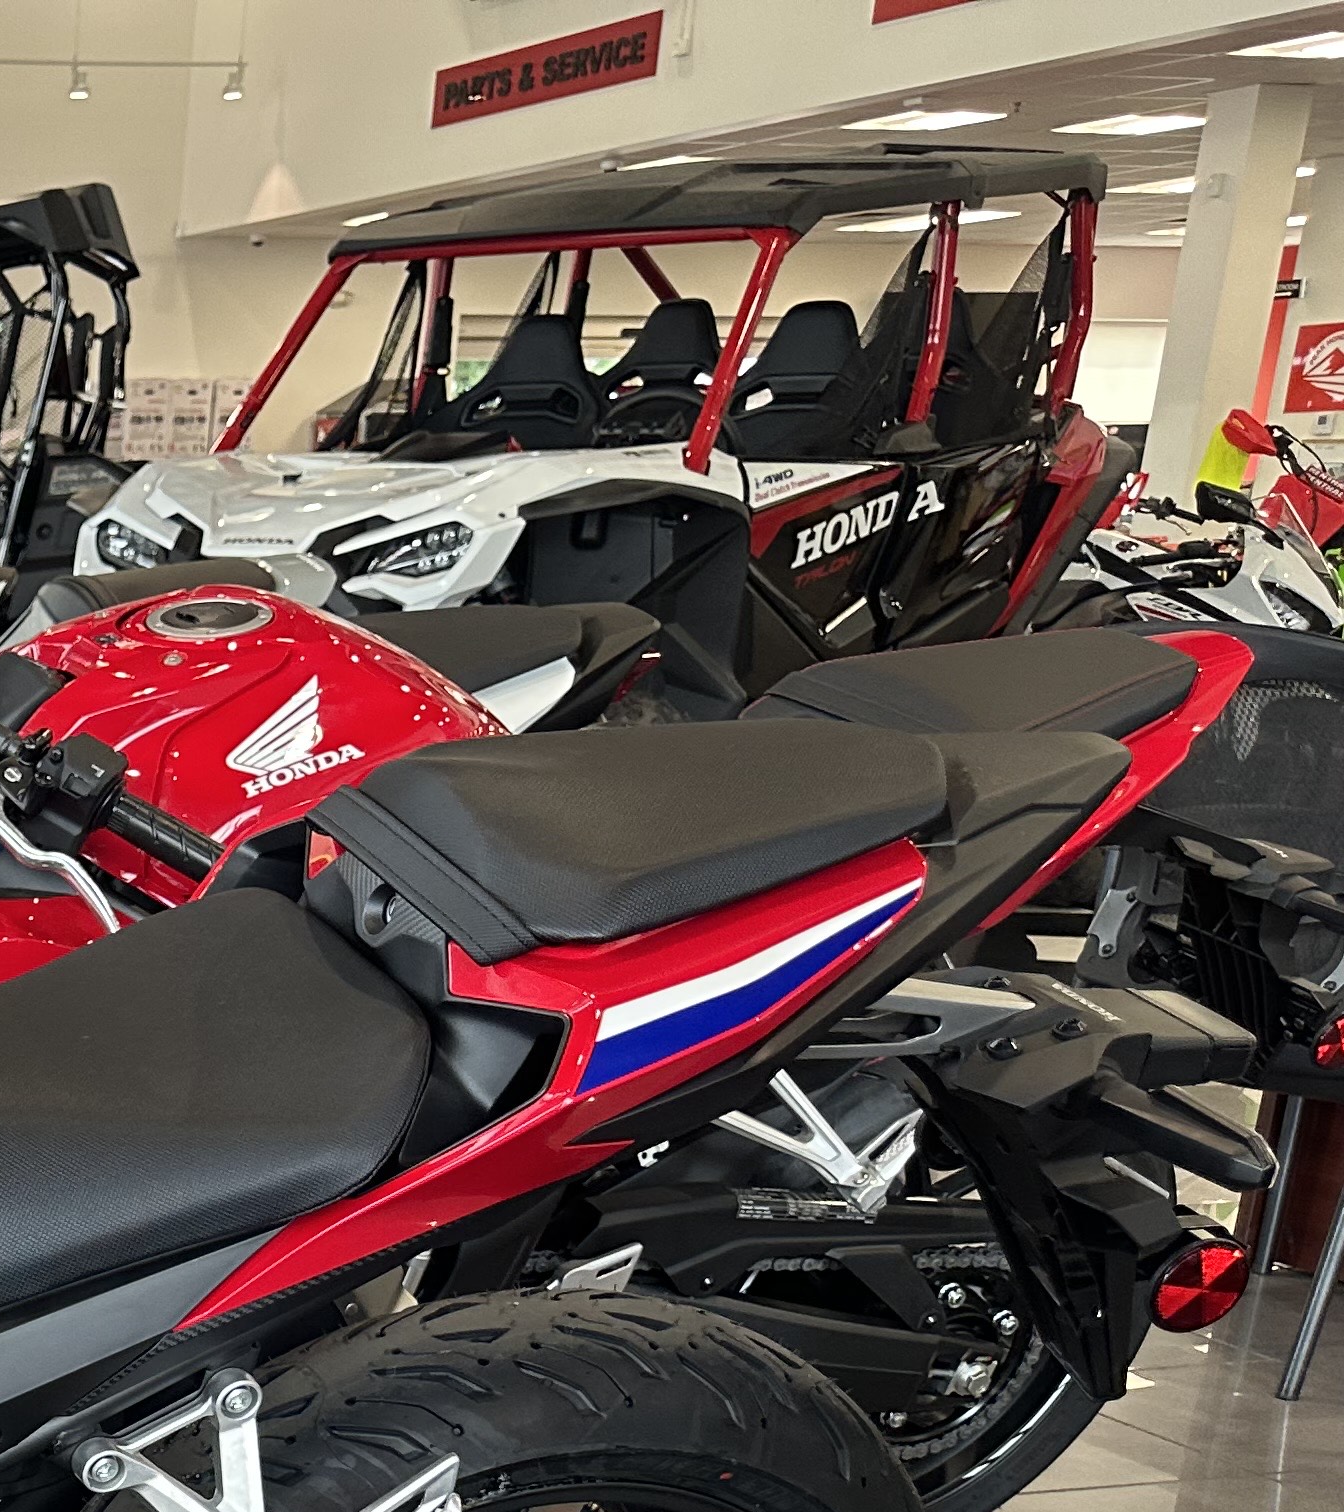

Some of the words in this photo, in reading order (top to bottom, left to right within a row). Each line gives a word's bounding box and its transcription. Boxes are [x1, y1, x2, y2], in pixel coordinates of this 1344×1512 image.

[442, 68, 512, 112] PARTS
[517, 61, 535, 93] &
[541, 31, 648, 87] SERVICE
[790, 480, 946, 570] HONDA
[240, 744, 366, 799] HONDA
